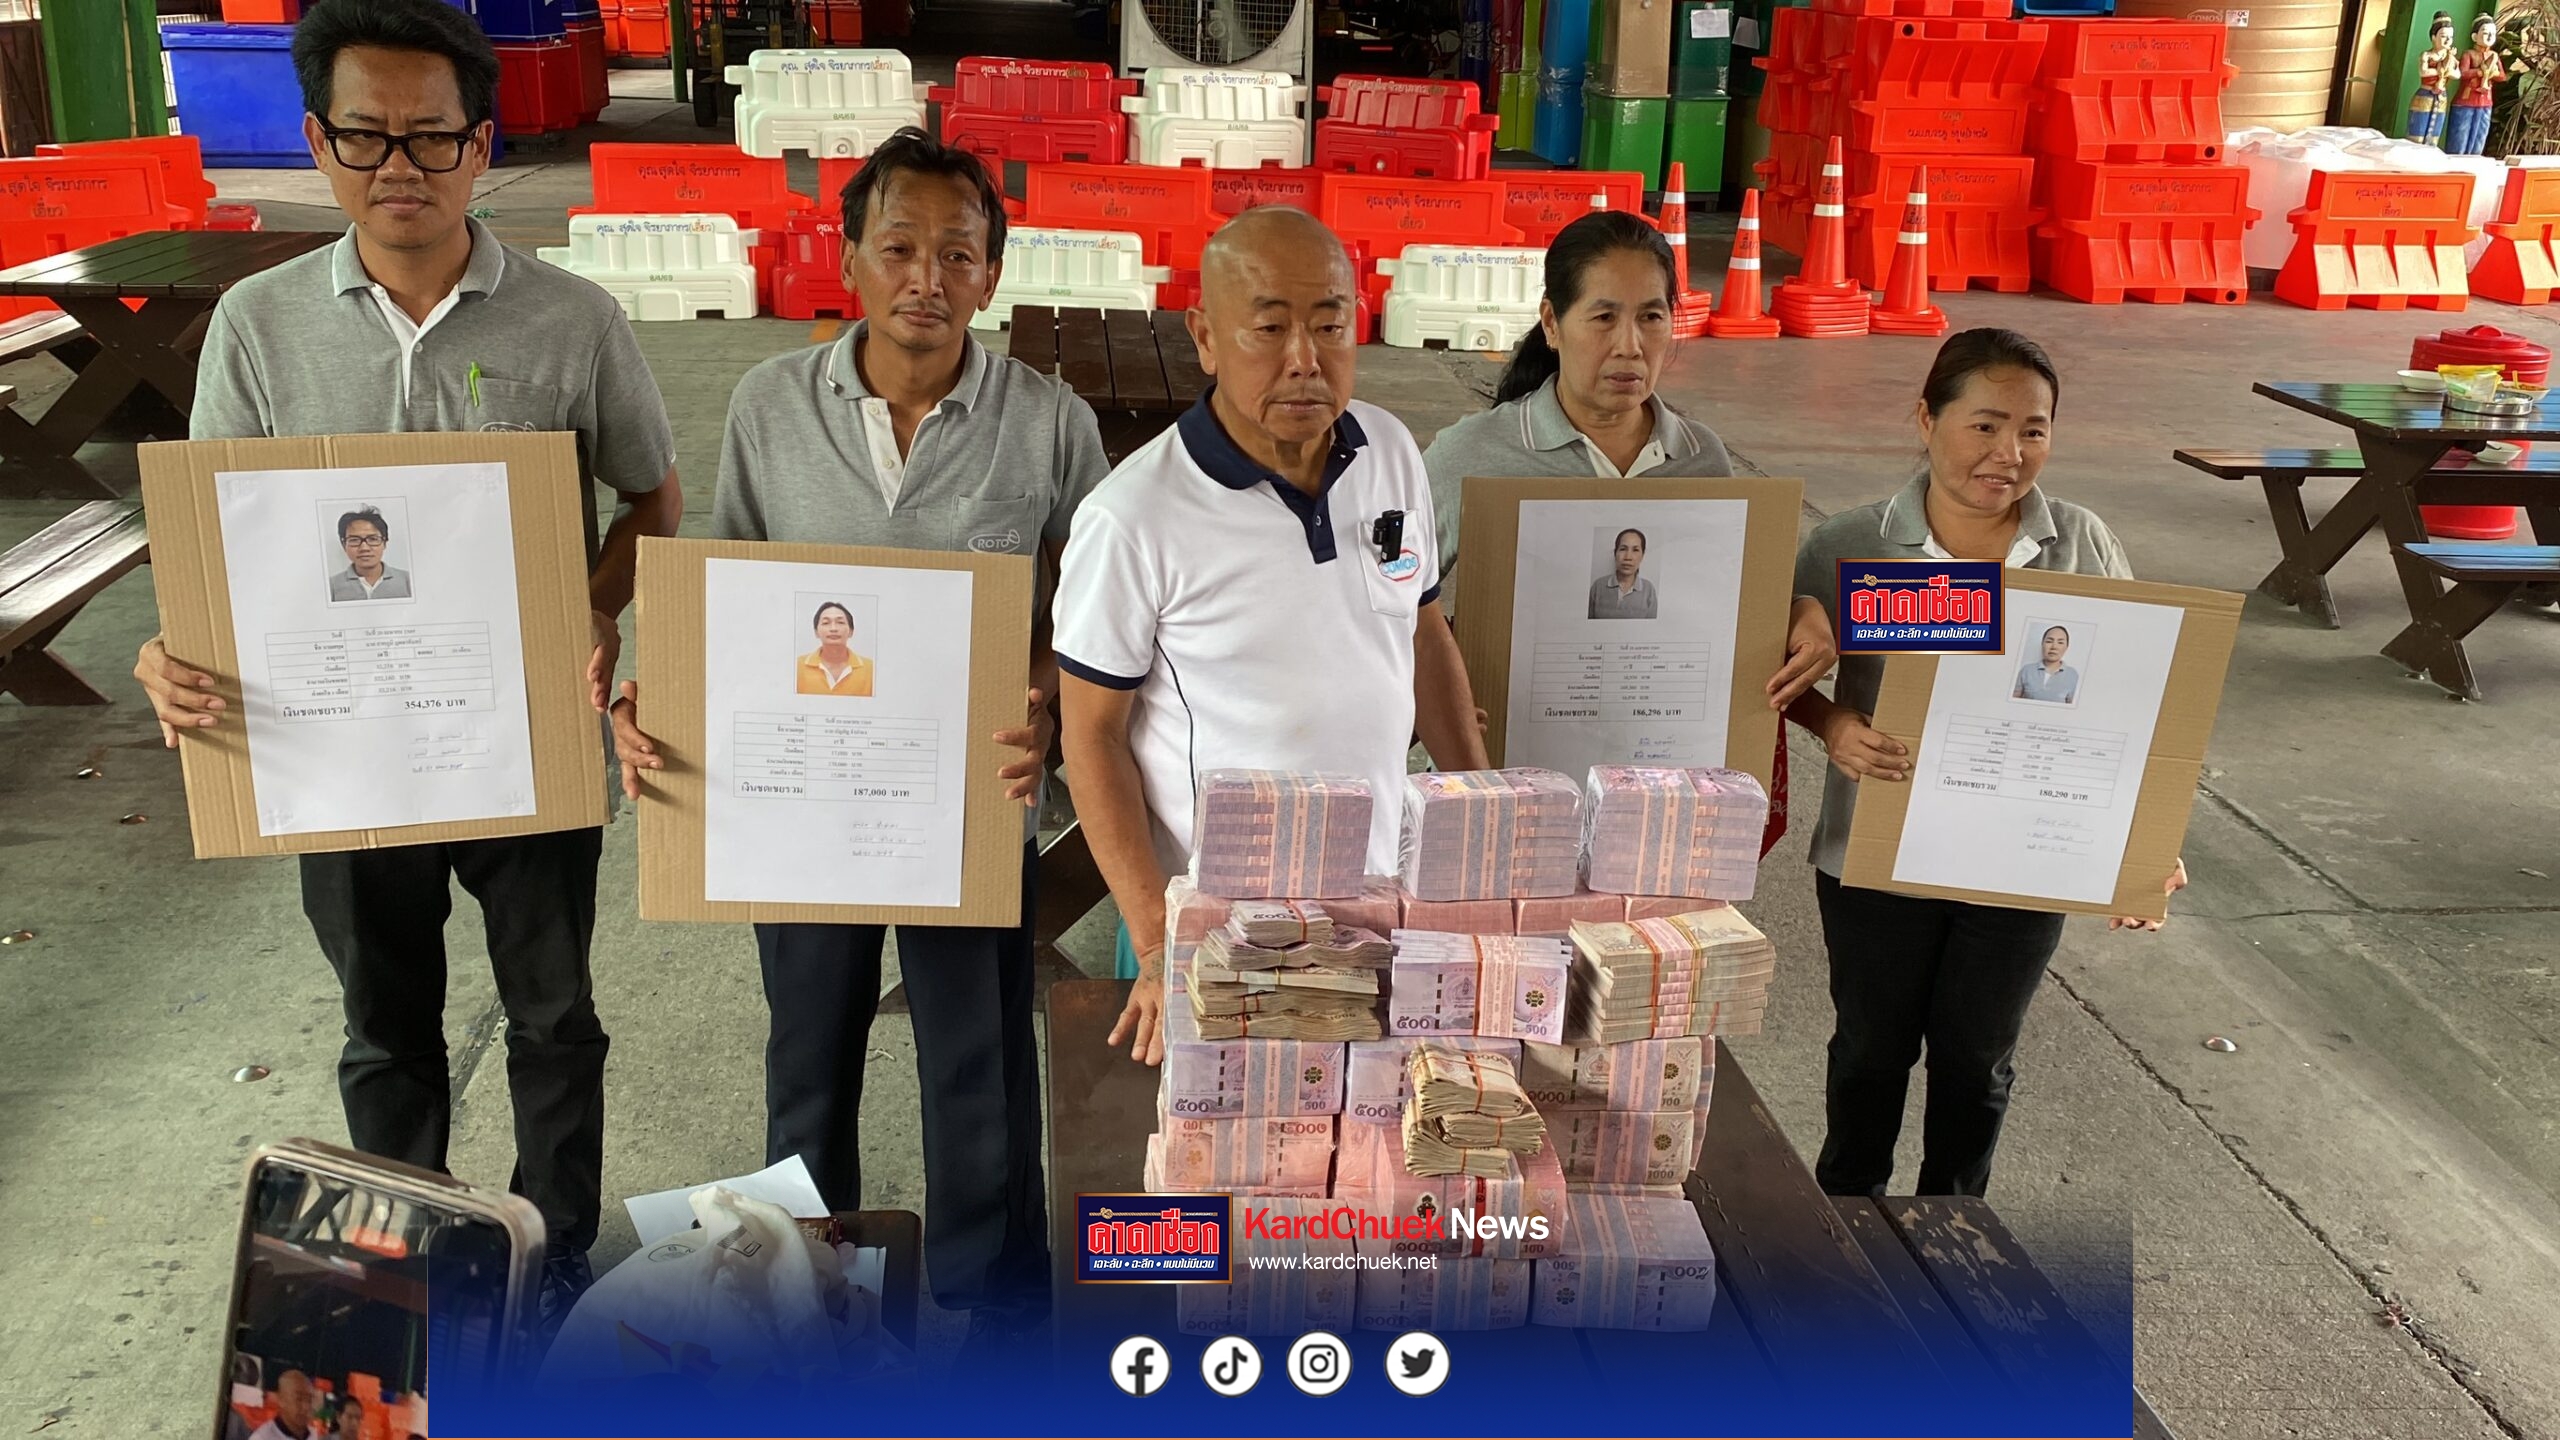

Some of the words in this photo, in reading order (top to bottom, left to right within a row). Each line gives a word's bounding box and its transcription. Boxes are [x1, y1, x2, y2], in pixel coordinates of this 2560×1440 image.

[977, 539, 1010, 549] ROTO
[405, 700, 442, 710] 354,376
[447, 698, 467, 707] บาท
[1632, 708, 1662, 717] 186,296
[854, 788, 887, 797] 187,000
[2039, 788, 2069, 799] 180,290
[1396, 1015, 1430, 1030] ๕๐๐
[1525, 1024, 1547, 1036] 500
[1175, 1097, 1209, 1113] ๕๐๐
[1304, 1101, 1326, 1111] 500
[1354, 1103, 1388, 1117] ๕๐๐
